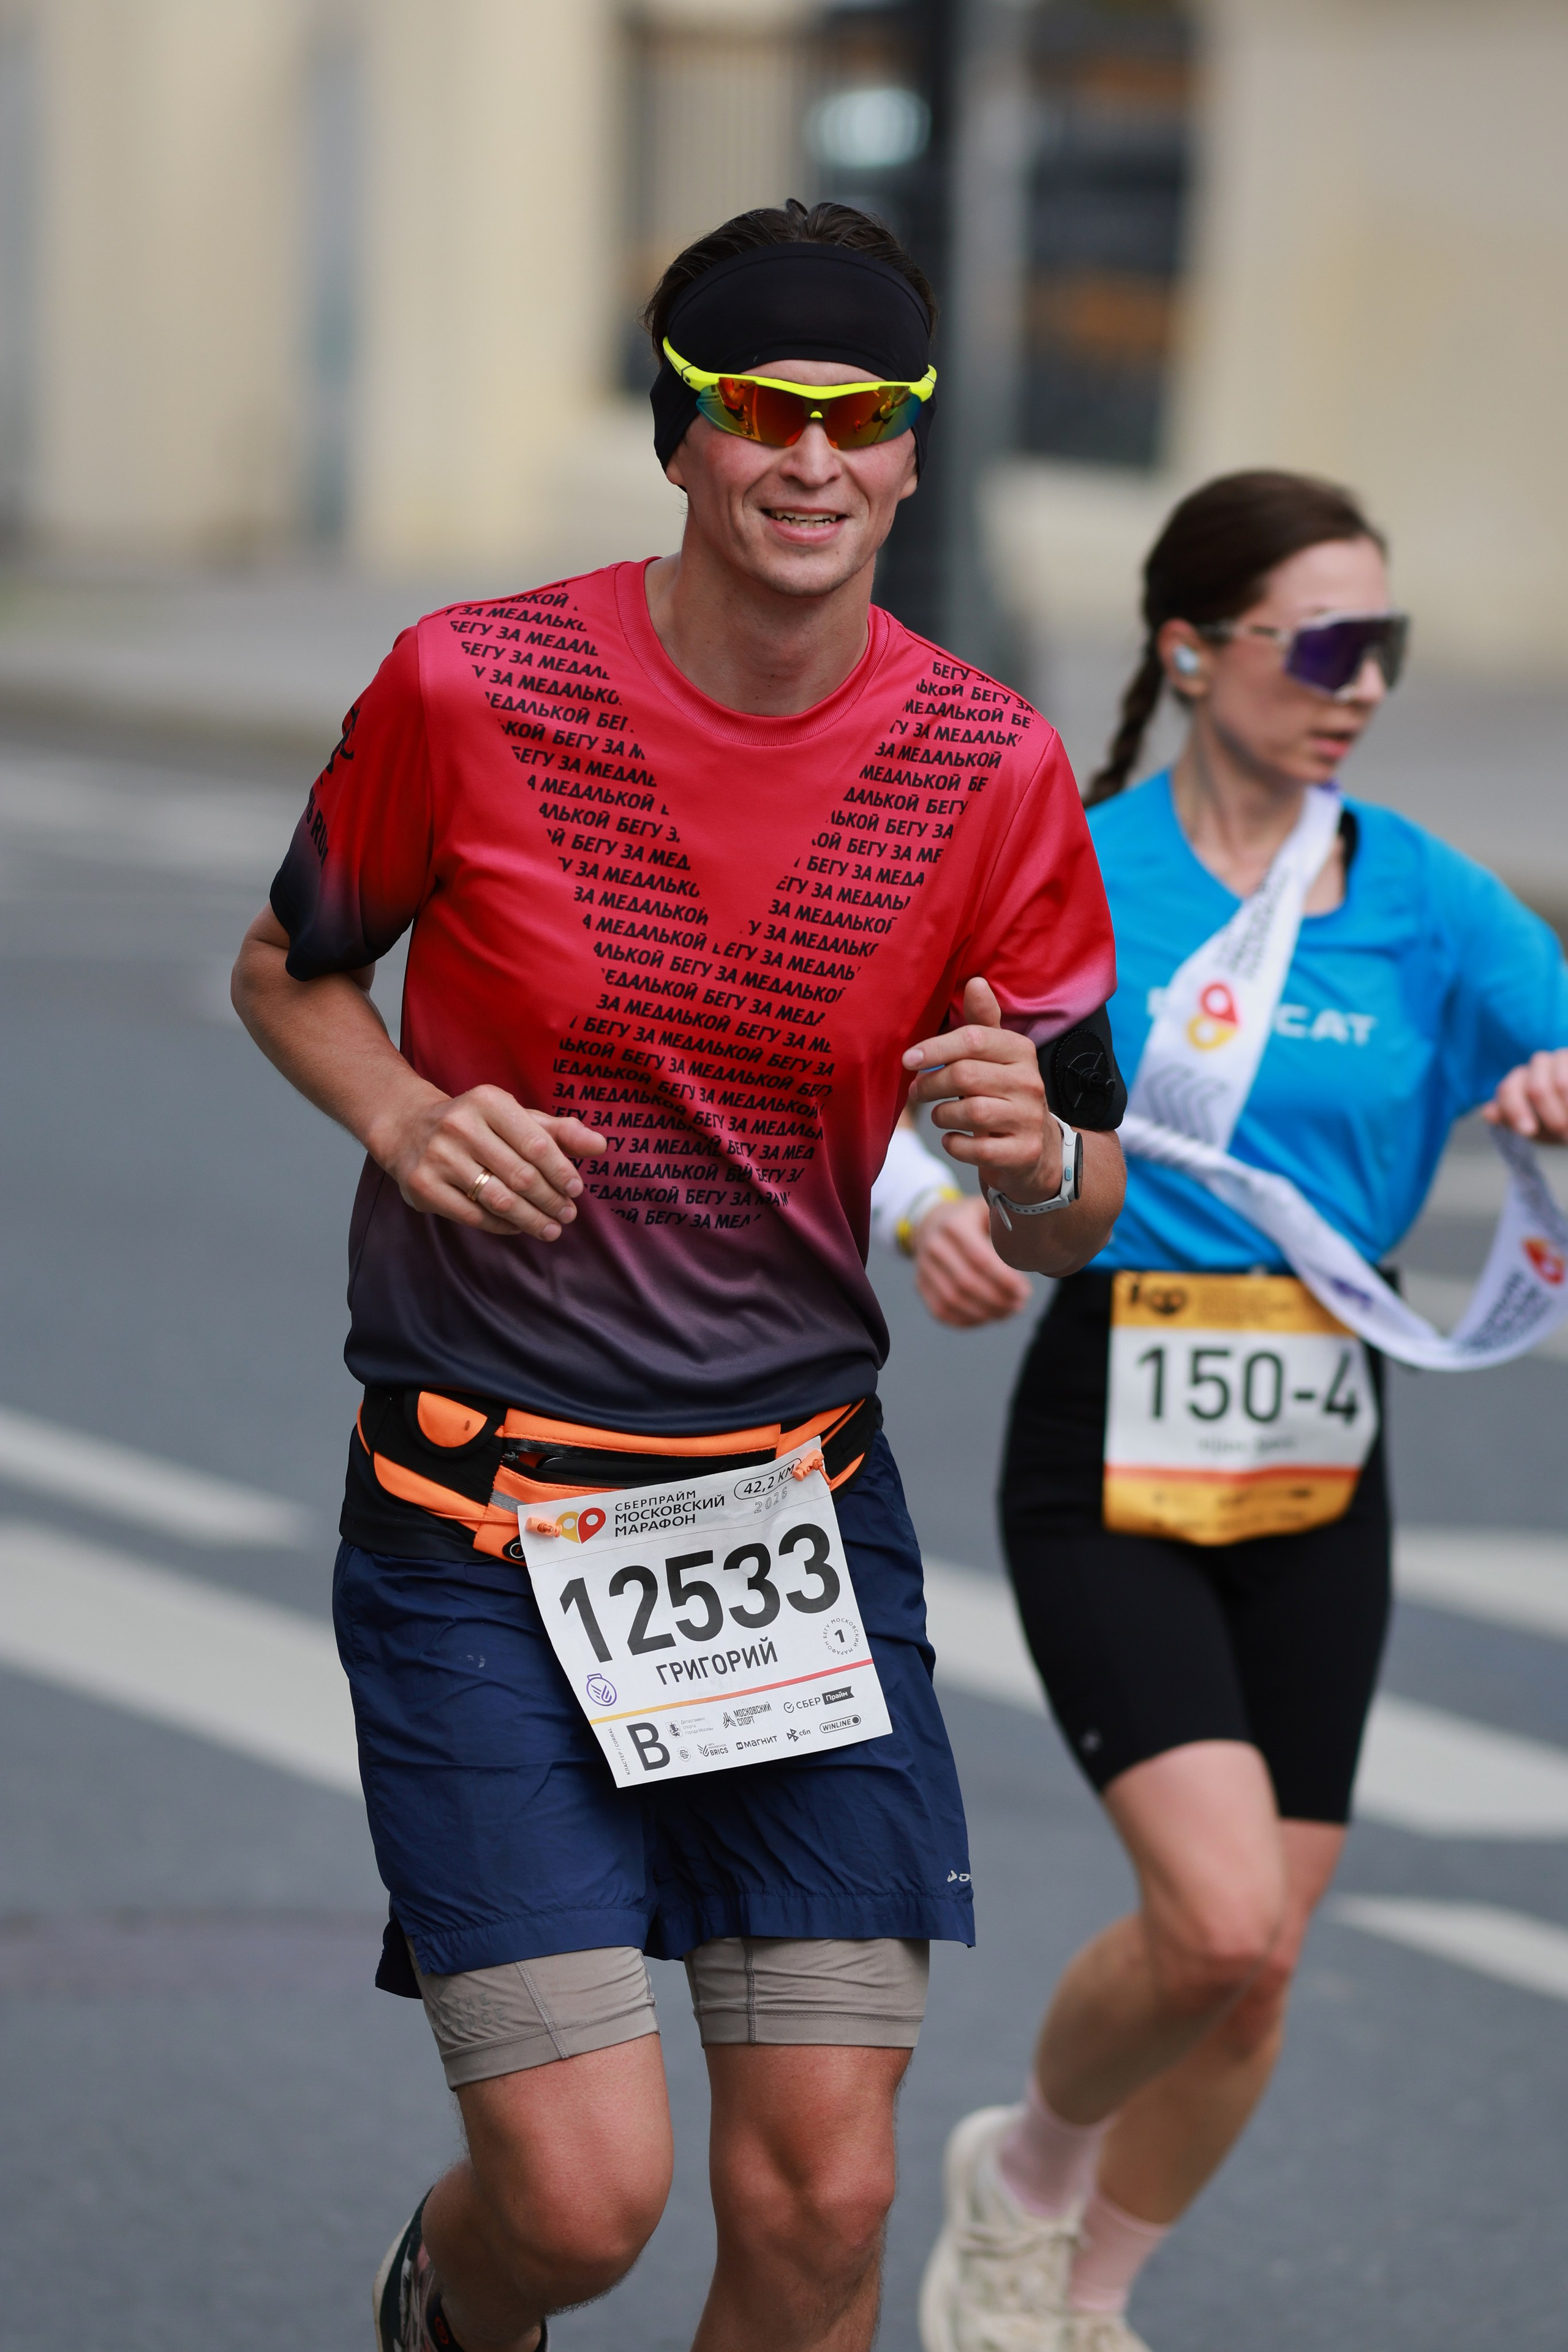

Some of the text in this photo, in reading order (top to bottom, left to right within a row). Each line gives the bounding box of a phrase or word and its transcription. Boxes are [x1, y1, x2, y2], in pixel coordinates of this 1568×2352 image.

[459, 607, 483, 616] ЗА
[497, 627, 520, 641] ЗА
[510, 650, 532, 666] ЗА
[490, 669, 512, 686] ЗА
[933, 662, 970, 680] БЕГУ
[916, 679, 963, 696] ЬКОЙ
[971, 687, 1011, 704] БЕГУ
[486, 692, 590, 725] ЕДАЛЬКОЙ
[906, 699, 1030, 728] МЕДАЛЬКОЙ БЕ
[502, 721, 545, 741] КОЙ
[552, 730, 598, 750] БЕГУ
[602, 739, 624, 756] ЗА
[913, 723, 930, 739] ЗА
[934, 726, 1018, 747] МЕДАЛЬК
[558, 755, 580, 772] ЗА
[875, 742, 1001, 768] ЗА МЕДАЛЬКОЙ
[859, 765, 988, 791] МЕДАЛЬКОЙ БЕ
[540, 777, 654, 811] МЕДАЛЬКОЙ
[843, 787, 968, 815] ДАЛЬКОЙ БЕГУ
[617, 817, 663, 838] БЕГУ
[885, 819, 953, 839] БЕГУ ЗА
[571, 834, 618, 855] БЕГУ
[621, 843, 644, 861] ЗА
[812, 832, 842, 850] ОЙ
[847, 838, 888, 857] БЕГУ
[891, 845, 911, 861] ЗА
[576, 861, 598, 879] ЗА
[807, 856, 924, 886] БЕГУ ЗА МЕДА
[812, 883, 832, 900] ЗА
[575, 886, 708, 925] ЗА МЕДАЛЬКОЙ
[769, 899, 790, 917] ЗА
[764, 924, 786, 942] ЗА
[596, 917, 707, 951] МЕДАЛЬКОЙ
[760, 949, 783, 968] ЗА
[786, 956, 854, 980] МЕДАЛЬ
[670, 956, 712, 977] БЕГУ
[715, 966, 737, 983] ЗА
[602, 968, 772, 1017] ЕДАЛЬКОЙ БЕГУ ЗА
[597, 994, 620, 1011] ЗА
[624, 999, 731, 1033] МЕДАЛЬКОЙ
[735, 1022, 781, 1042] БЕГУ
[782, 1032, 805, 1049] ЗА
[584, 1017, 834, 1076] БЕГУ ЗА МЕДАЛЬКОЙ БЕГУ ЗА
[621, 1049, 665, 1069] БЕГУ
[669, 1058, 684, 1074] ЗА
[688, 1061, 794, 1090] МЕДАЛЬКОЙ
[553, 1083, 575, 1099] ЗА
[579, 1085, 686, 1116] МЕДАЛЬКОЙ
[693, 1111, 724, 1128] БЕГУ
[728, 1117, 747, 1133] ЗА
[658, 1081, 695, 1099] БЕГУ
[700, 1087, 715, 1103] ЗА
[718, 1091, 817, 1118] МЕДАЛЬКОЙ
[591, 1111, 815, 1159] ЗА БЕГУ ЗА МЕД
[587, 1160, 609, 1176] ЗА
[613, 1163, 718, 1181] МЕДАЛЬКОЙ
[629, 1138, 649, 1153] ЗА
[756, 1169, 788, 1183] БЕГУ
[584, 1184, 751, 1205] ЕДАЛЬКОЙ БЕГУ ЗА
[645, 1210, 710, 1229] БЕГУ ЗА
[1137, 1345, 1359, 1426] 150-4
[744, 1476, 774, 1495] 42,2
[616, 1490, 696, 1512] СБЕРПРАЙМ
[616, 1494, 725, 1525] МОСКОВСКИЙ
[754, 1487, 788, 1513] 2026
[616, 1514, 696, 1537] МАРАФОН
[559, 1523, 840, 1663] 12533
[831, 1618, 859, 1647] МОСКОВСКИЙ
[834, 1629, 845, 1643] 1
[824, 1641, 853, 1655] МАРАФОН
[655, 1636, 778, 1686] ГРИГОРИЙ
[733, 1702, 772, 1717] МОСКОВСКИЙ
[796, 1691, 848, 1709] СБЕР Прайм
[736, 1716, 755, 1727] СПОРТ
[823, 1719, 851, 1731] WINLINE
[608, 1727, 620, 1747] CORRAL
[618, 1751, 631, 1775] КЛАСТЕР
[710, 1747, 728, 1756] BRICS
